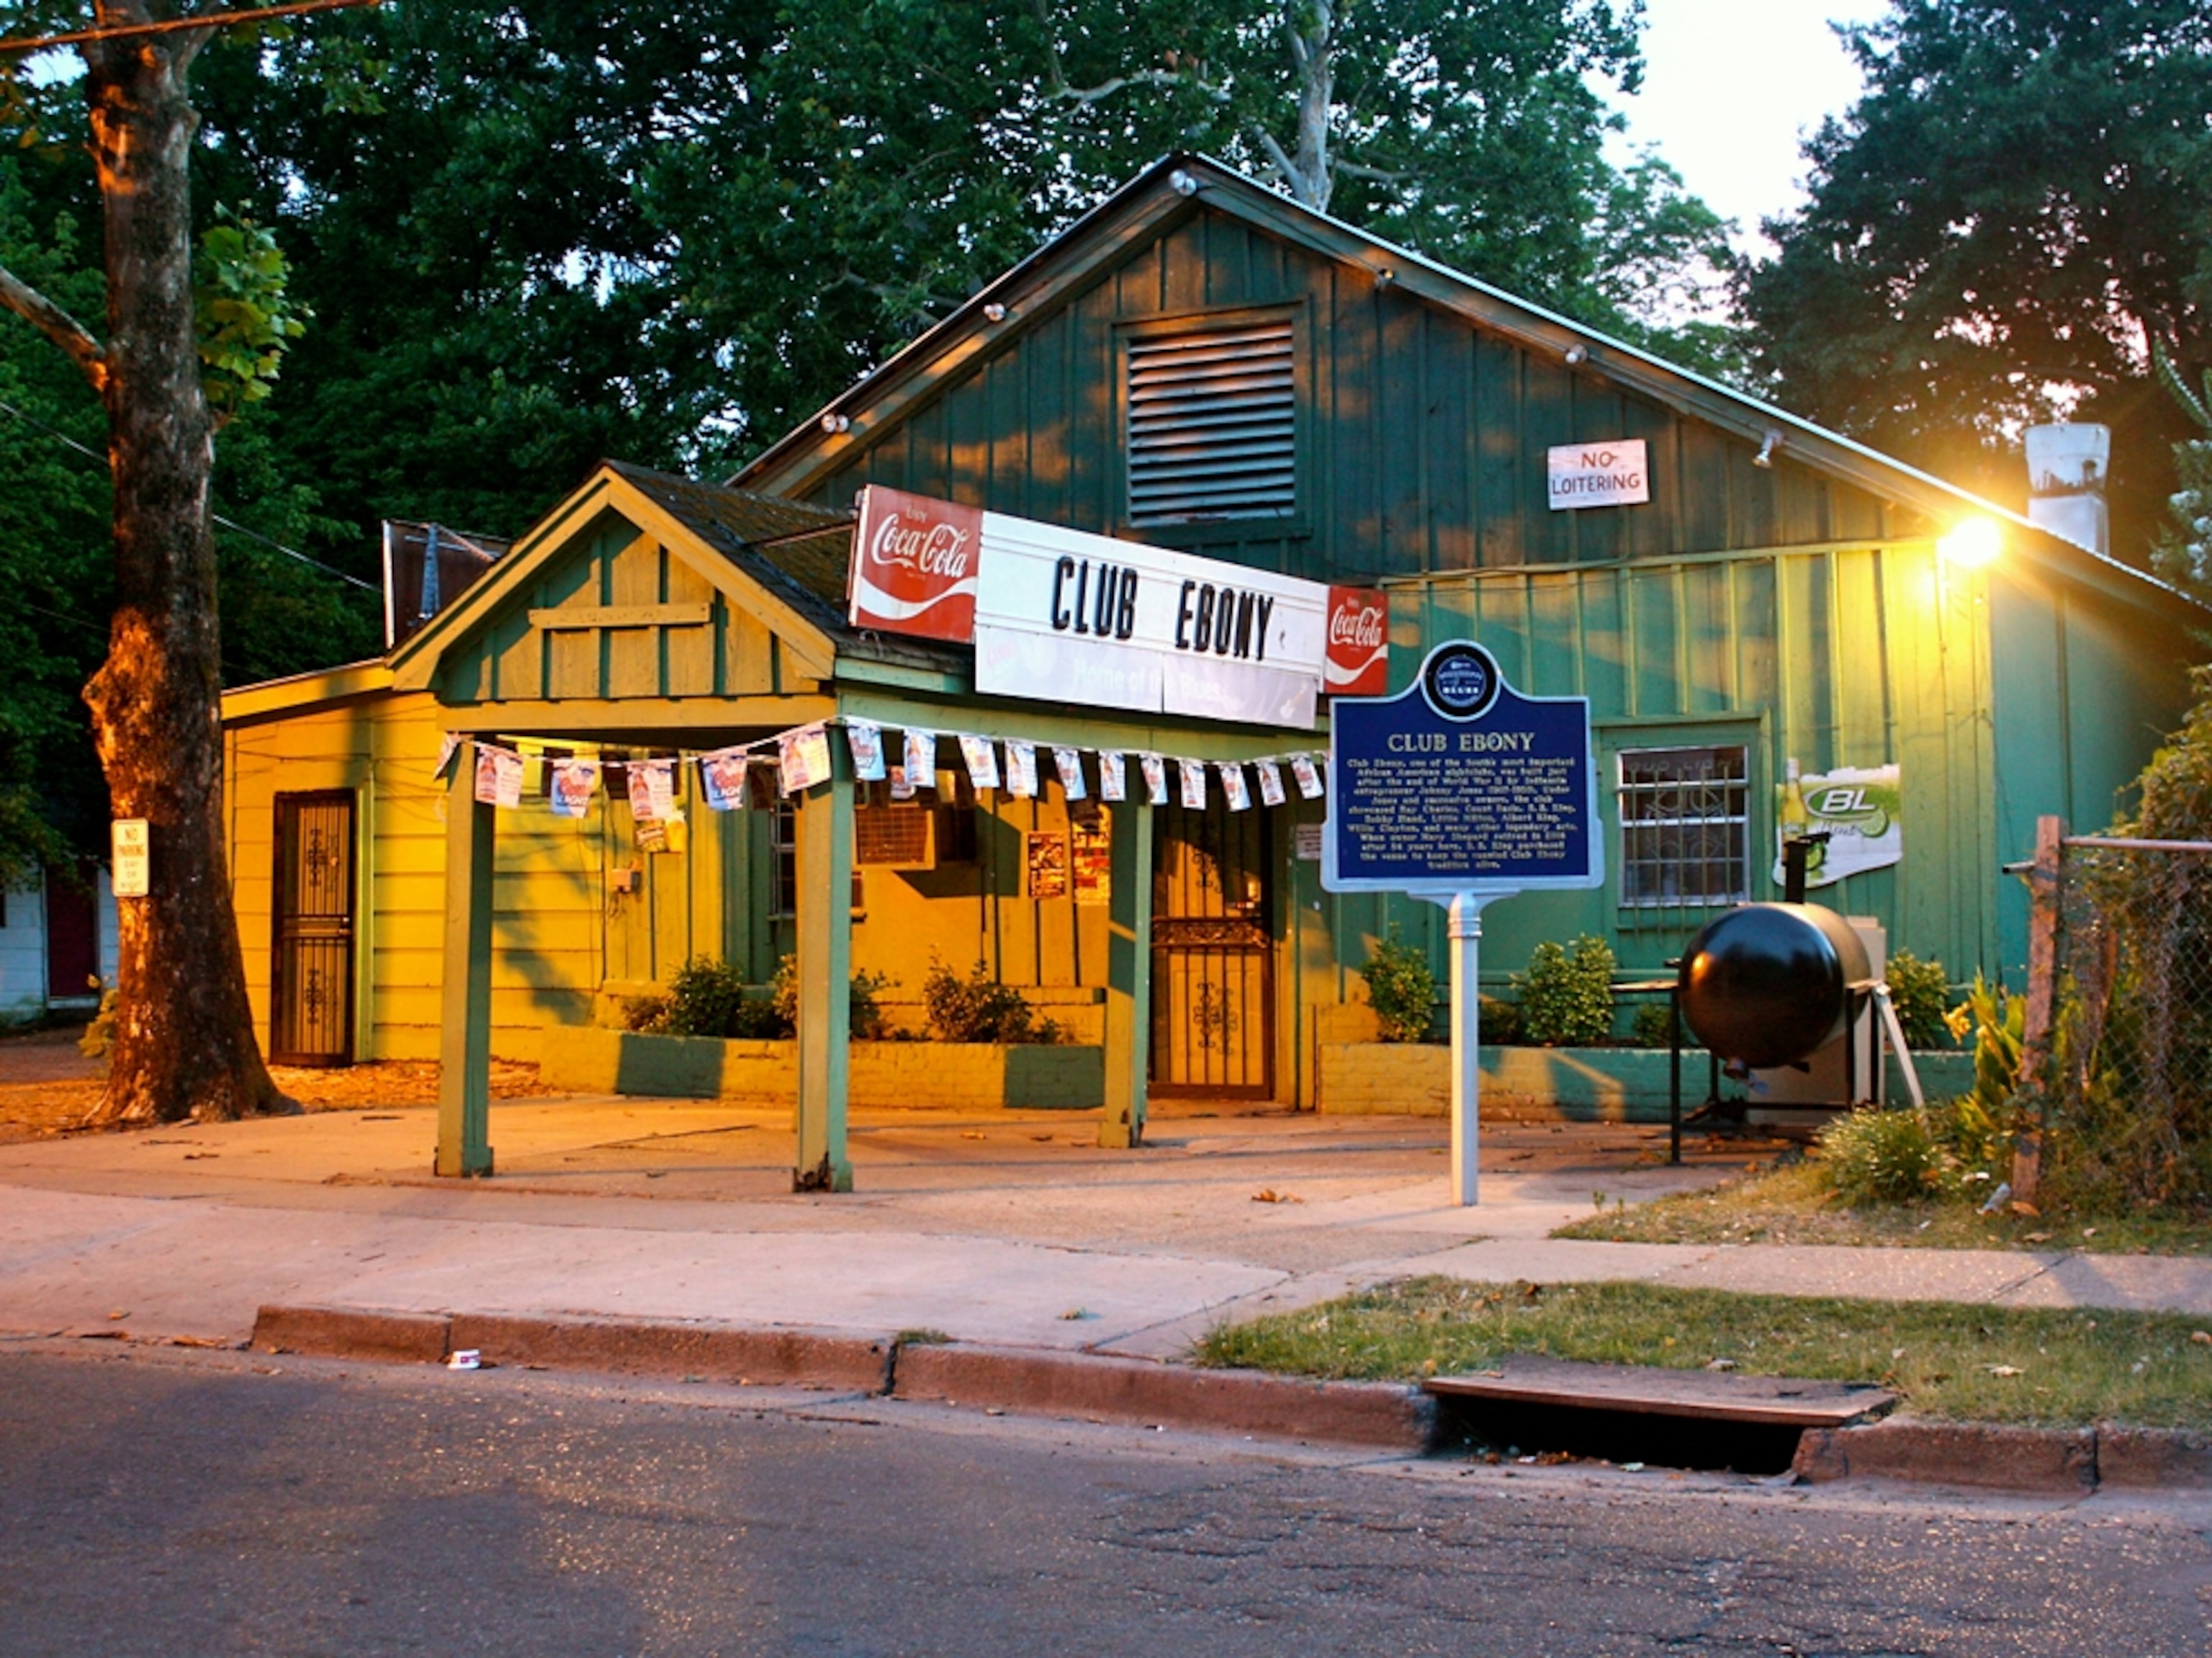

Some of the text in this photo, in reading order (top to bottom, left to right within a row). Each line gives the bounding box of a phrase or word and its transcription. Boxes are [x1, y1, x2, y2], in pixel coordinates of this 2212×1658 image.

[1581, 451, 1614, 469] NO
[1552, 473, 1640, 494] LOITERING
[872, 513, 971, 578] Coca-Cola
[1051, 556, 1274, 661] CLUB EBONY
[1330, 604, 1383, 647] Coca-Cola
[1074, 656, 1124, 689] Home
[1130, 667, 1146, 692] of
[1387, 732, 1536, 752] CLUB EBONY
[1821, 788, 1877, 813] BL
[125, 828, 139, 842] NO
